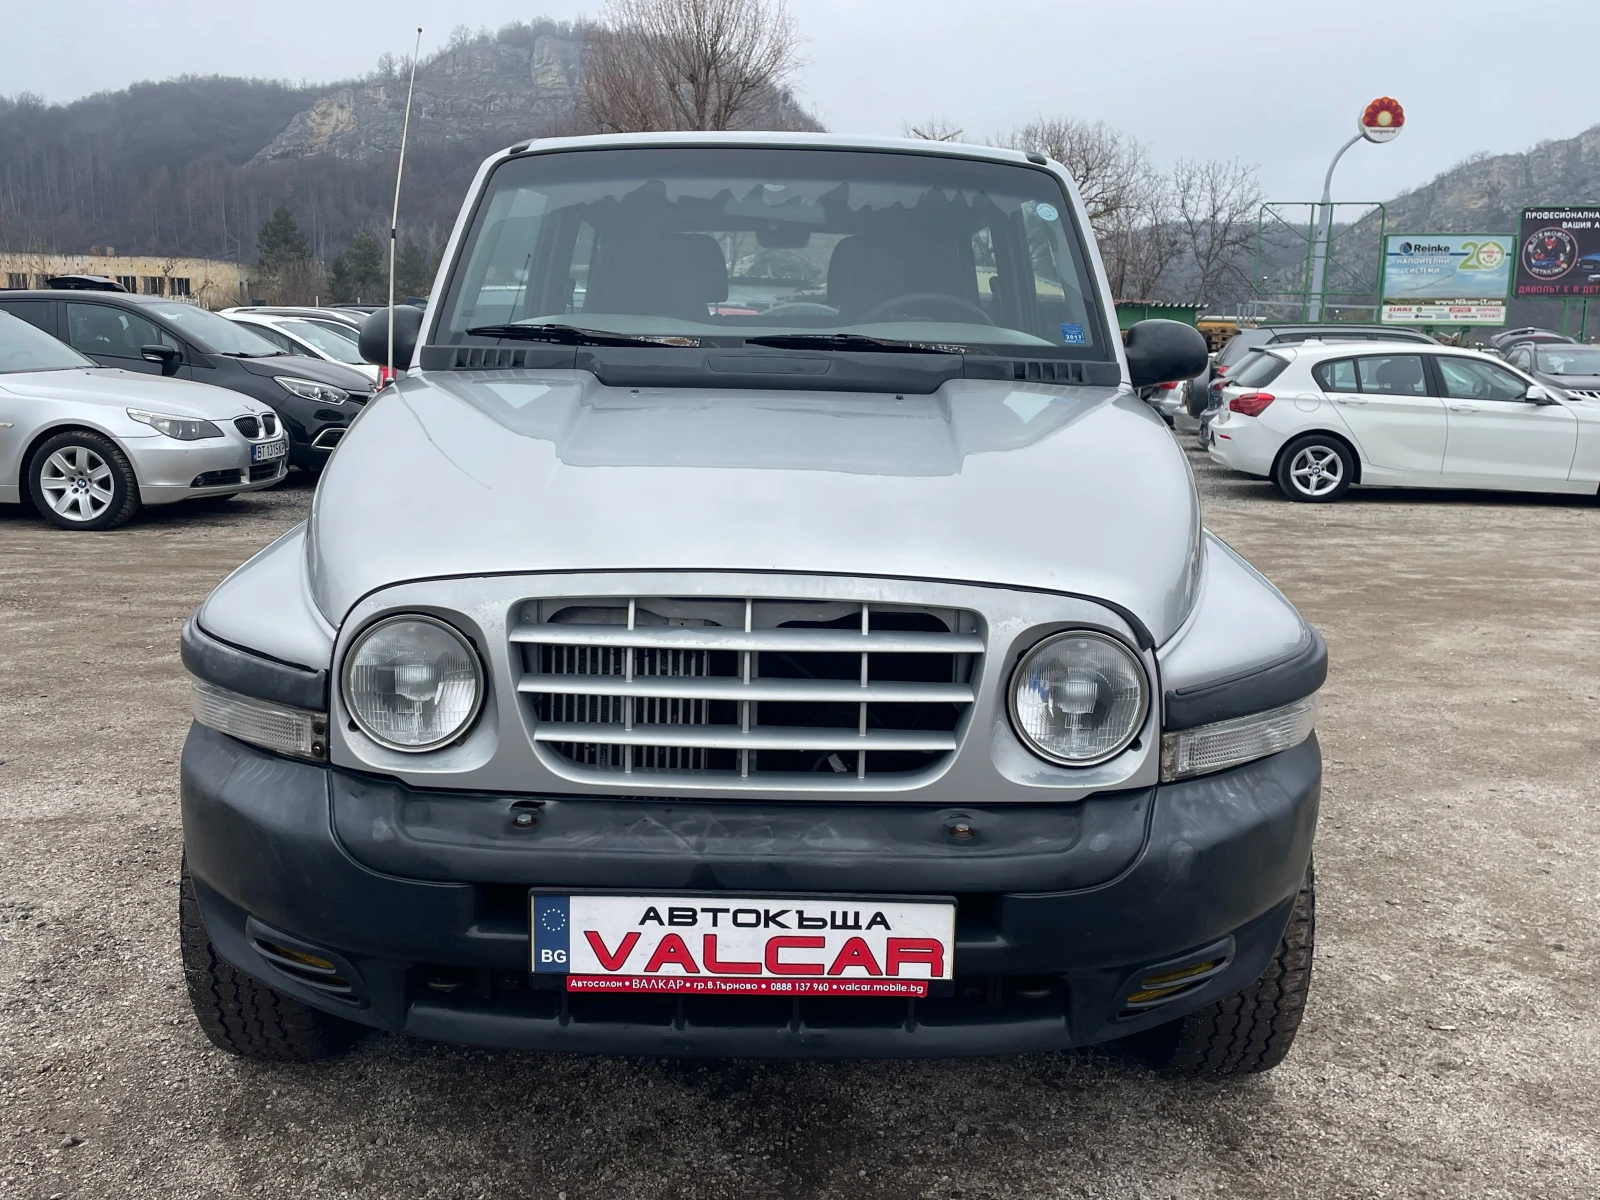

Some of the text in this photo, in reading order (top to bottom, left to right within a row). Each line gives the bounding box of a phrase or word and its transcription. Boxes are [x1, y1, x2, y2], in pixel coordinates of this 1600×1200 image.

[1562, 221, 1591, 229] ВАШИЯ
[1414, 244, 1450, 253] Reinke
[1397, 257, 1450, 265] НАПОИТЕЛНИ
[1582, 285, 1600, 294] ДЕТ
[638, 906, 891, 931] АВТОКЪЩА
[541, 949, 567, 963] BG
[583, 931, 945, 977] VALCAR
[570, 979, 924, 994] Автосалон ВАЛКАР гр.В.Търново 0888 137 960 valcar.mobile.bg
